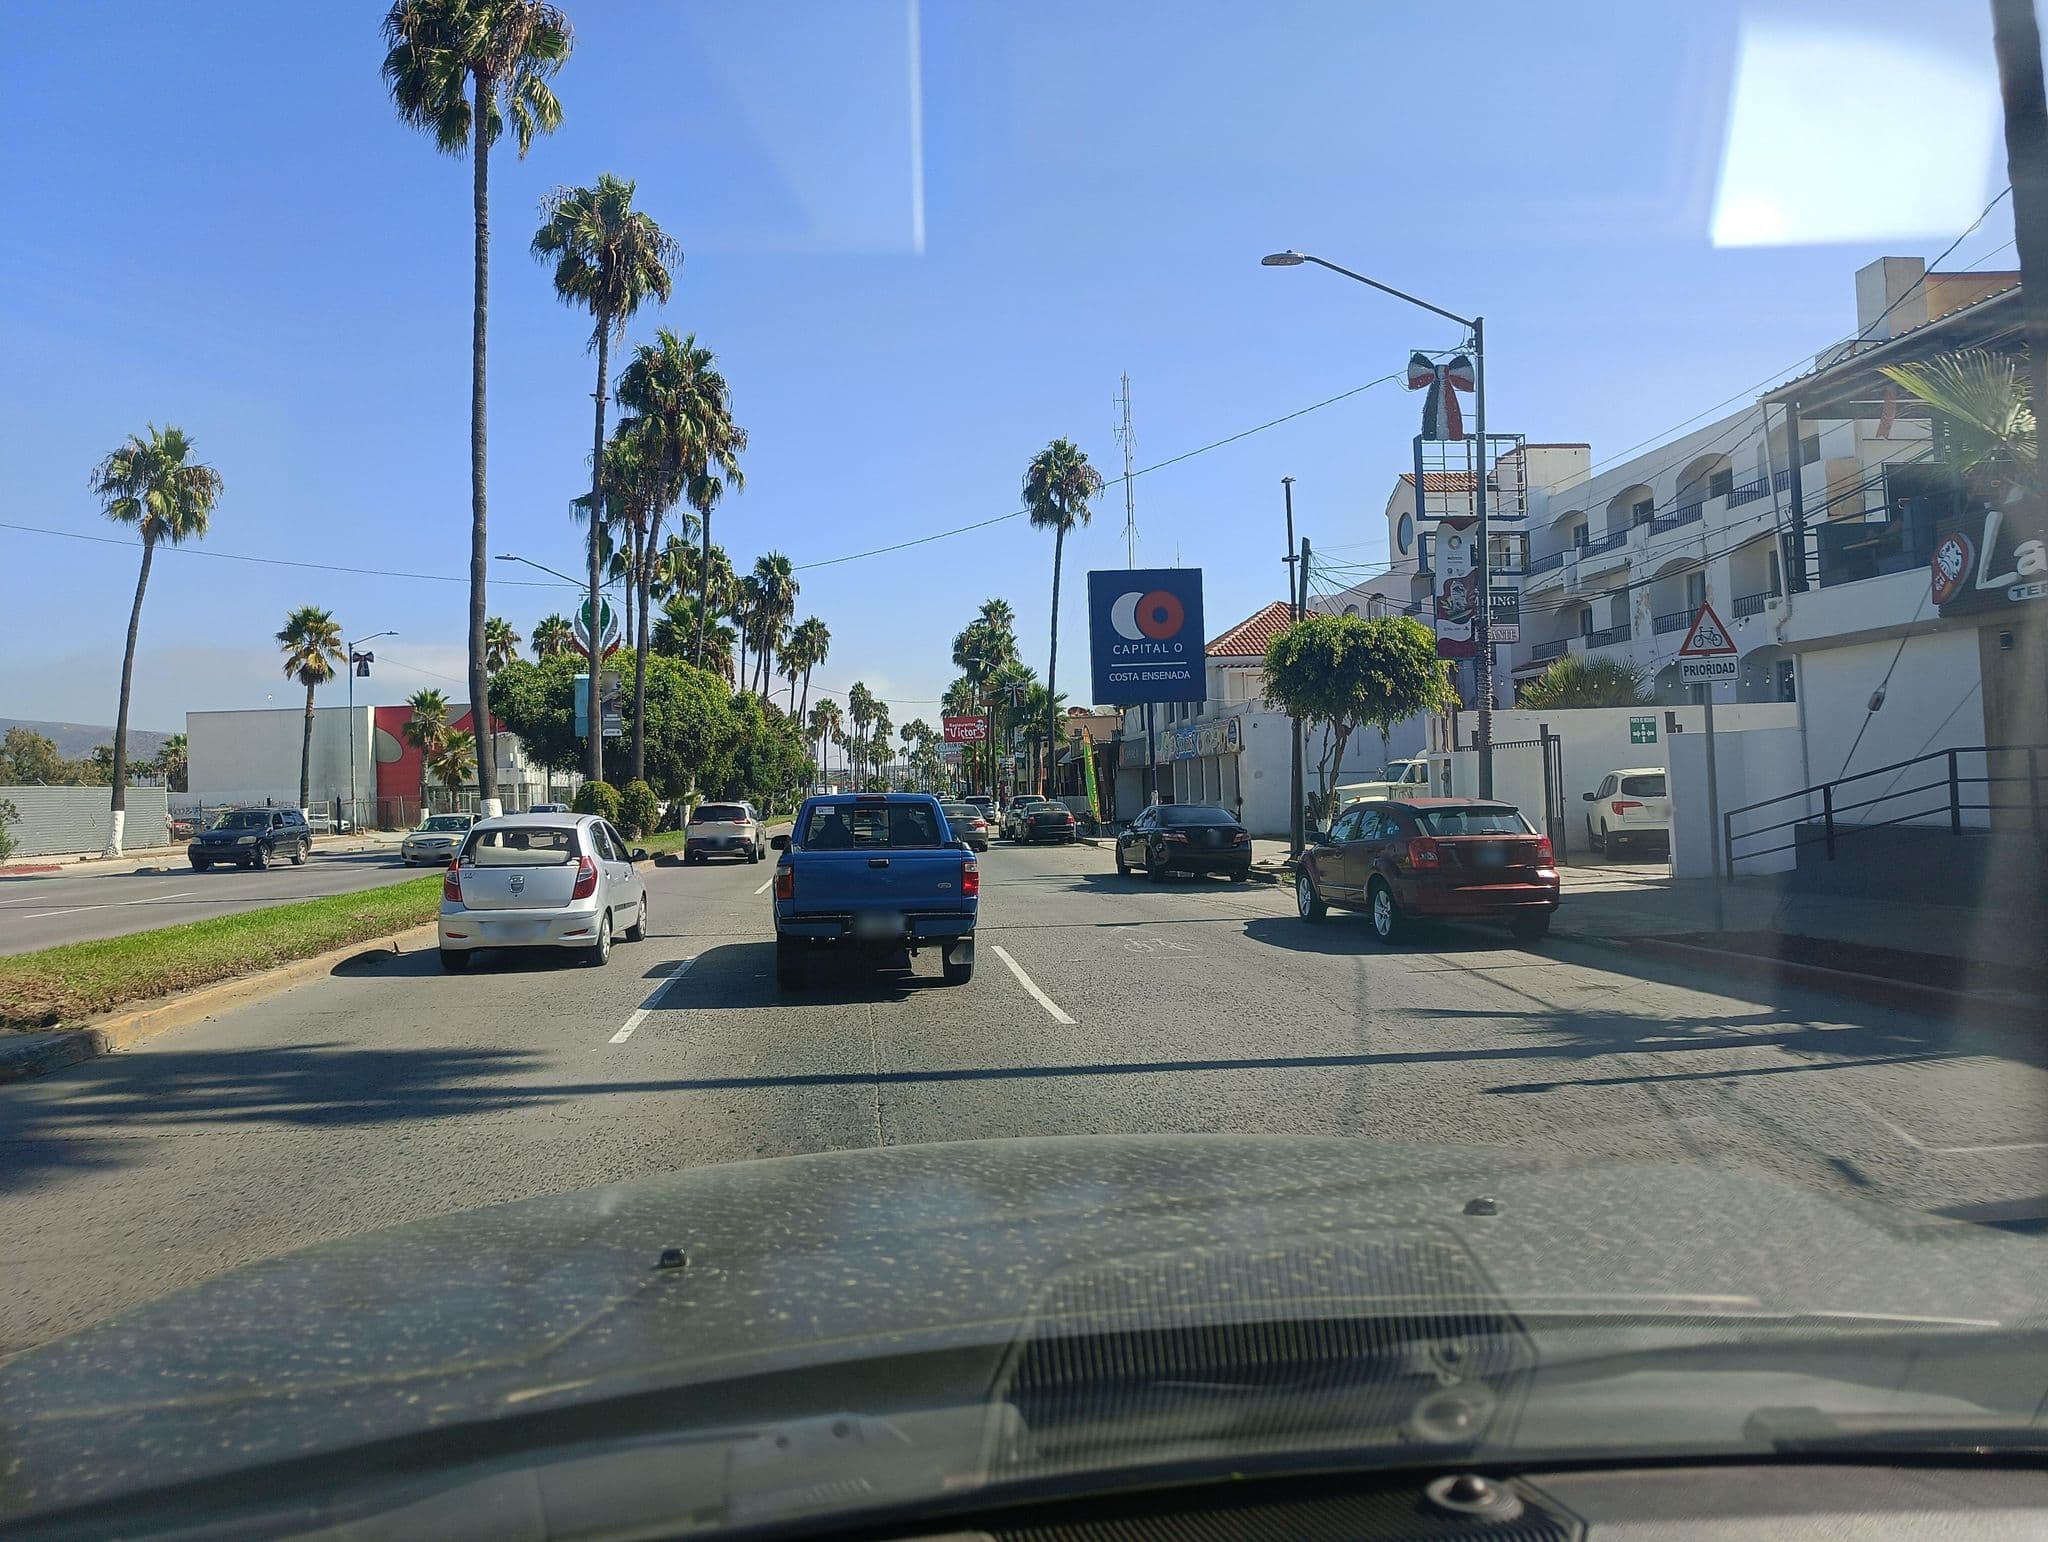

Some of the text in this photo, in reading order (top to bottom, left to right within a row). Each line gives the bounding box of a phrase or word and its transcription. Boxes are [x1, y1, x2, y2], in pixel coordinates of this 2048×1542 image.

[1112, 642, 1183, 655] CAPITAL O
[1683, 662, 1736, 676] PRIORIDAD
[1108, 670, 1191, 682] COSTA ENSENADA
